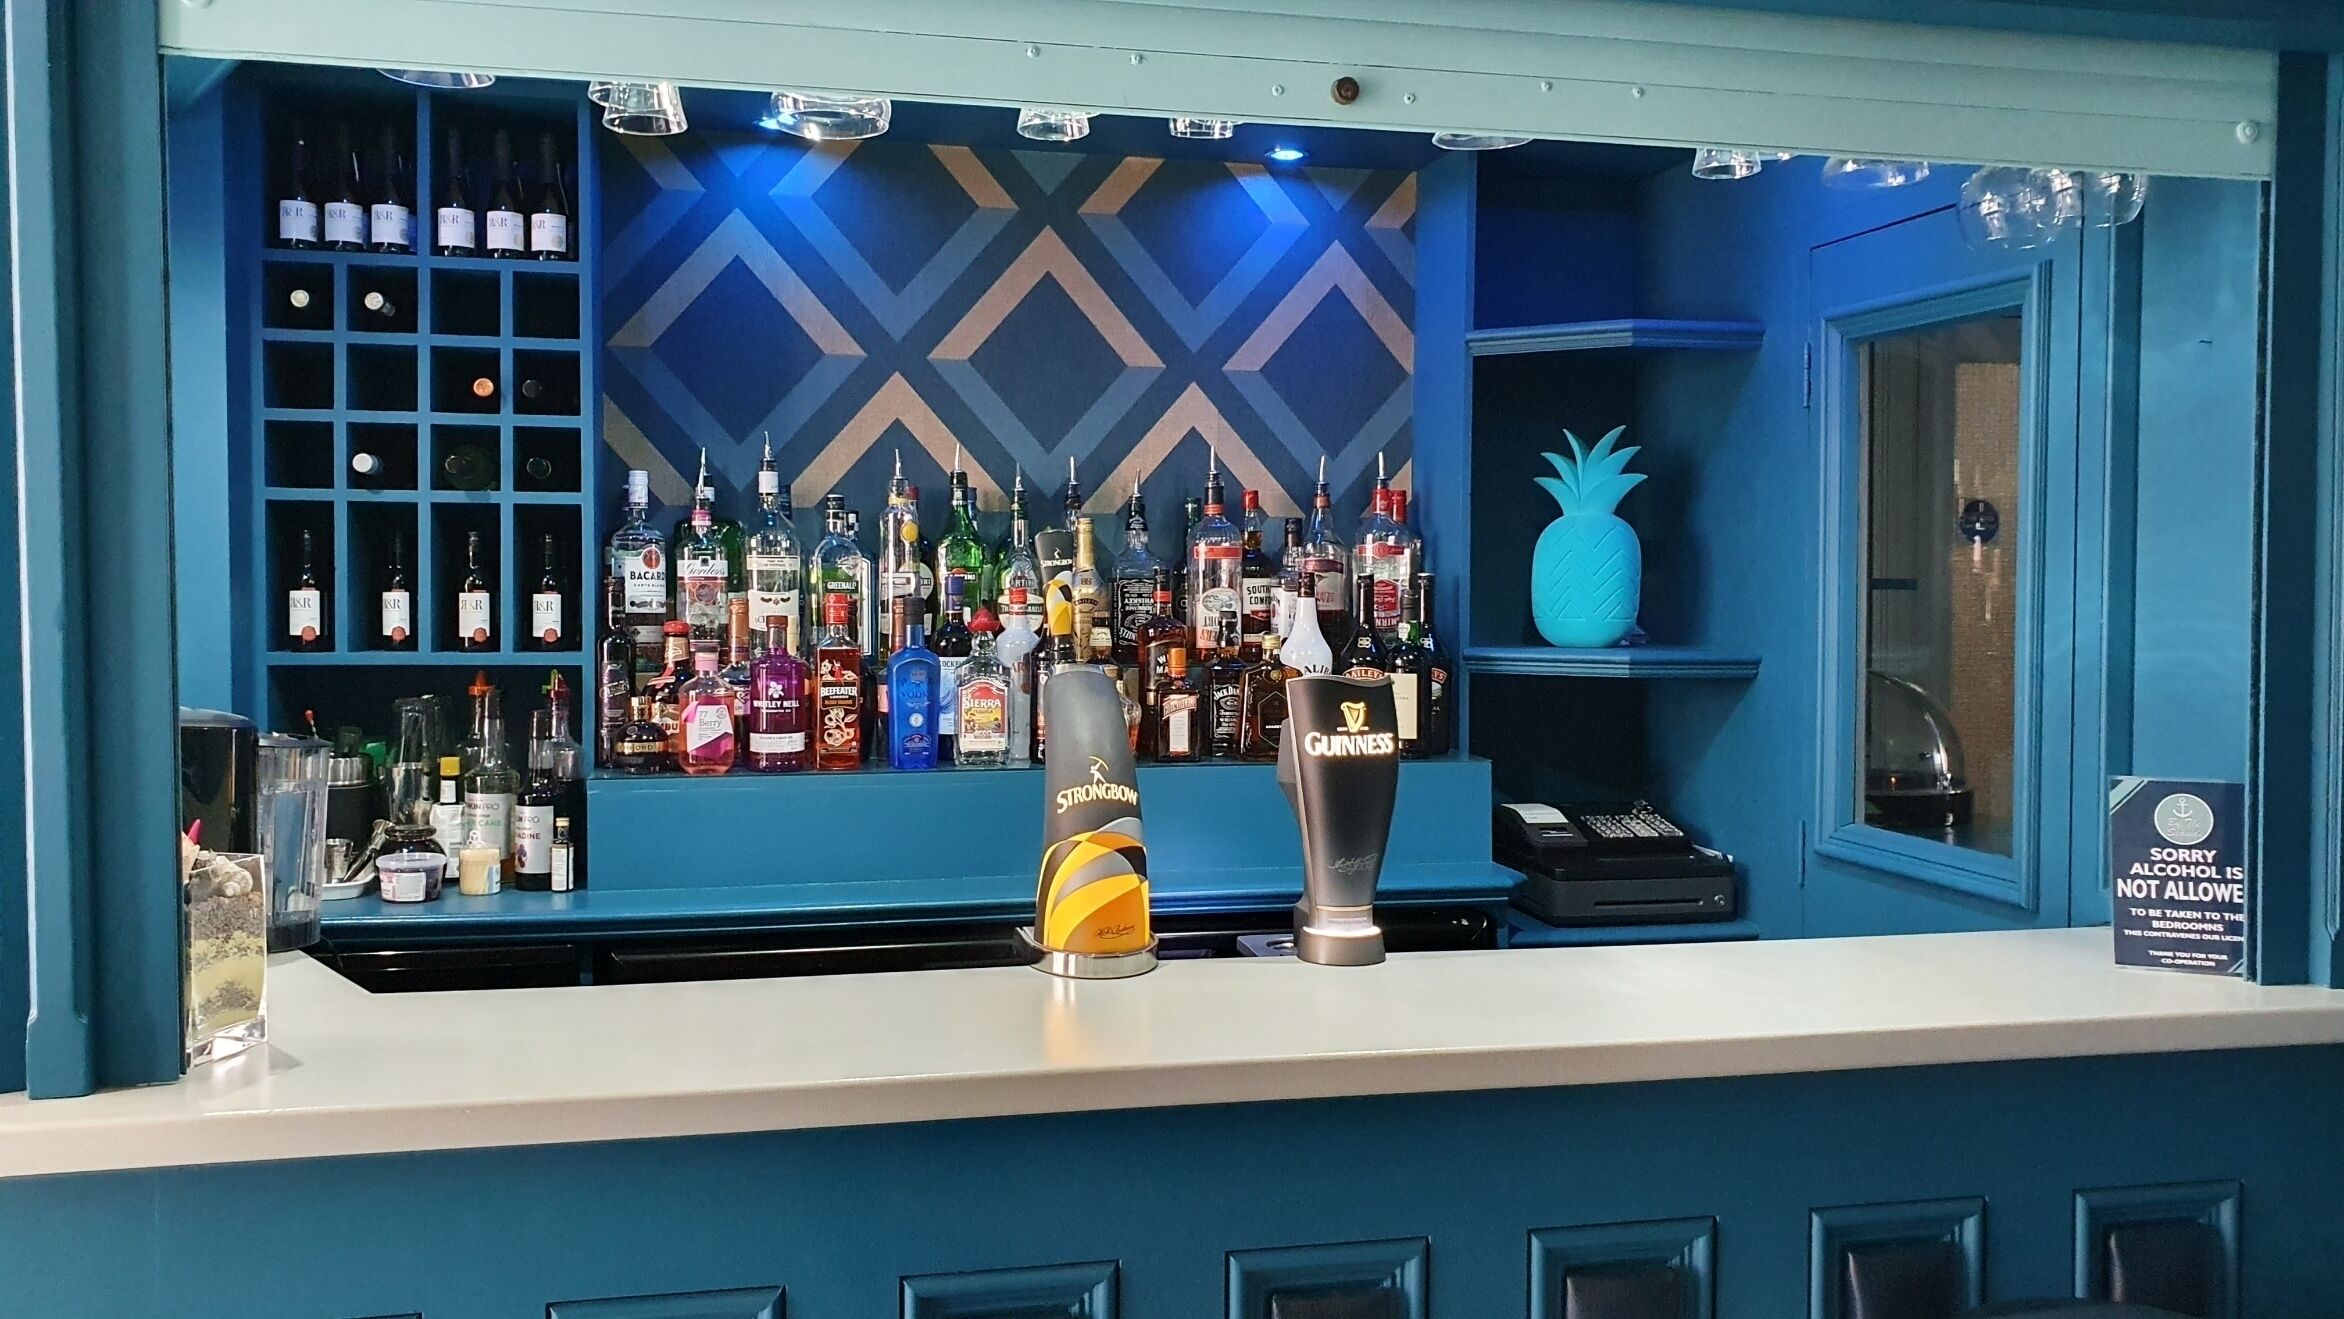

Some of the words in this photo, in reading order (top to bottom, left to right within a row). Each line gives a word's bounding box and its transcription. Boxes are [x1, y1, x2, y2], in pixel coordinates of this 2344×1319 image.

[821, 686, 858, 697] BEEFEATER
[753, 700, 782, 708] WHITLEY
[964, 698, 1002, 709] SIERRA
[699, 710, 707, 718] 77
[699, 719, 722, 729] Berry
[1303, 732, 1396, 757] GUINNESS
[1056, 782, 1139, 815] STRONGBOW
[2149, 847, 2217, 863] SORRY
[2129, 862, 2222, 879] ALCOHOL
[2226, 866, 2244, 880] IS
[2116, 878, 2160, 899] NOT
[2130, 907, 2147, 916] TO
[2148, 909, 2163, 918] BE
[2164, 909, 2202, 919] TAKEN
[2204, 912, 2221, 921] TO
[2223, 912, 2245, 922] THE
[2151, 920, 2225, 932] BEDROOMNS
[2123, 929, 2142, 937] THIS
[2143, 931, 2201, 940] CONTRAVENES
[2202, 933, 2220, 941] OUR
[2148, 950, 2174, 958] THANK
[2161, 957, 2216, 967] CO-OPERATION
